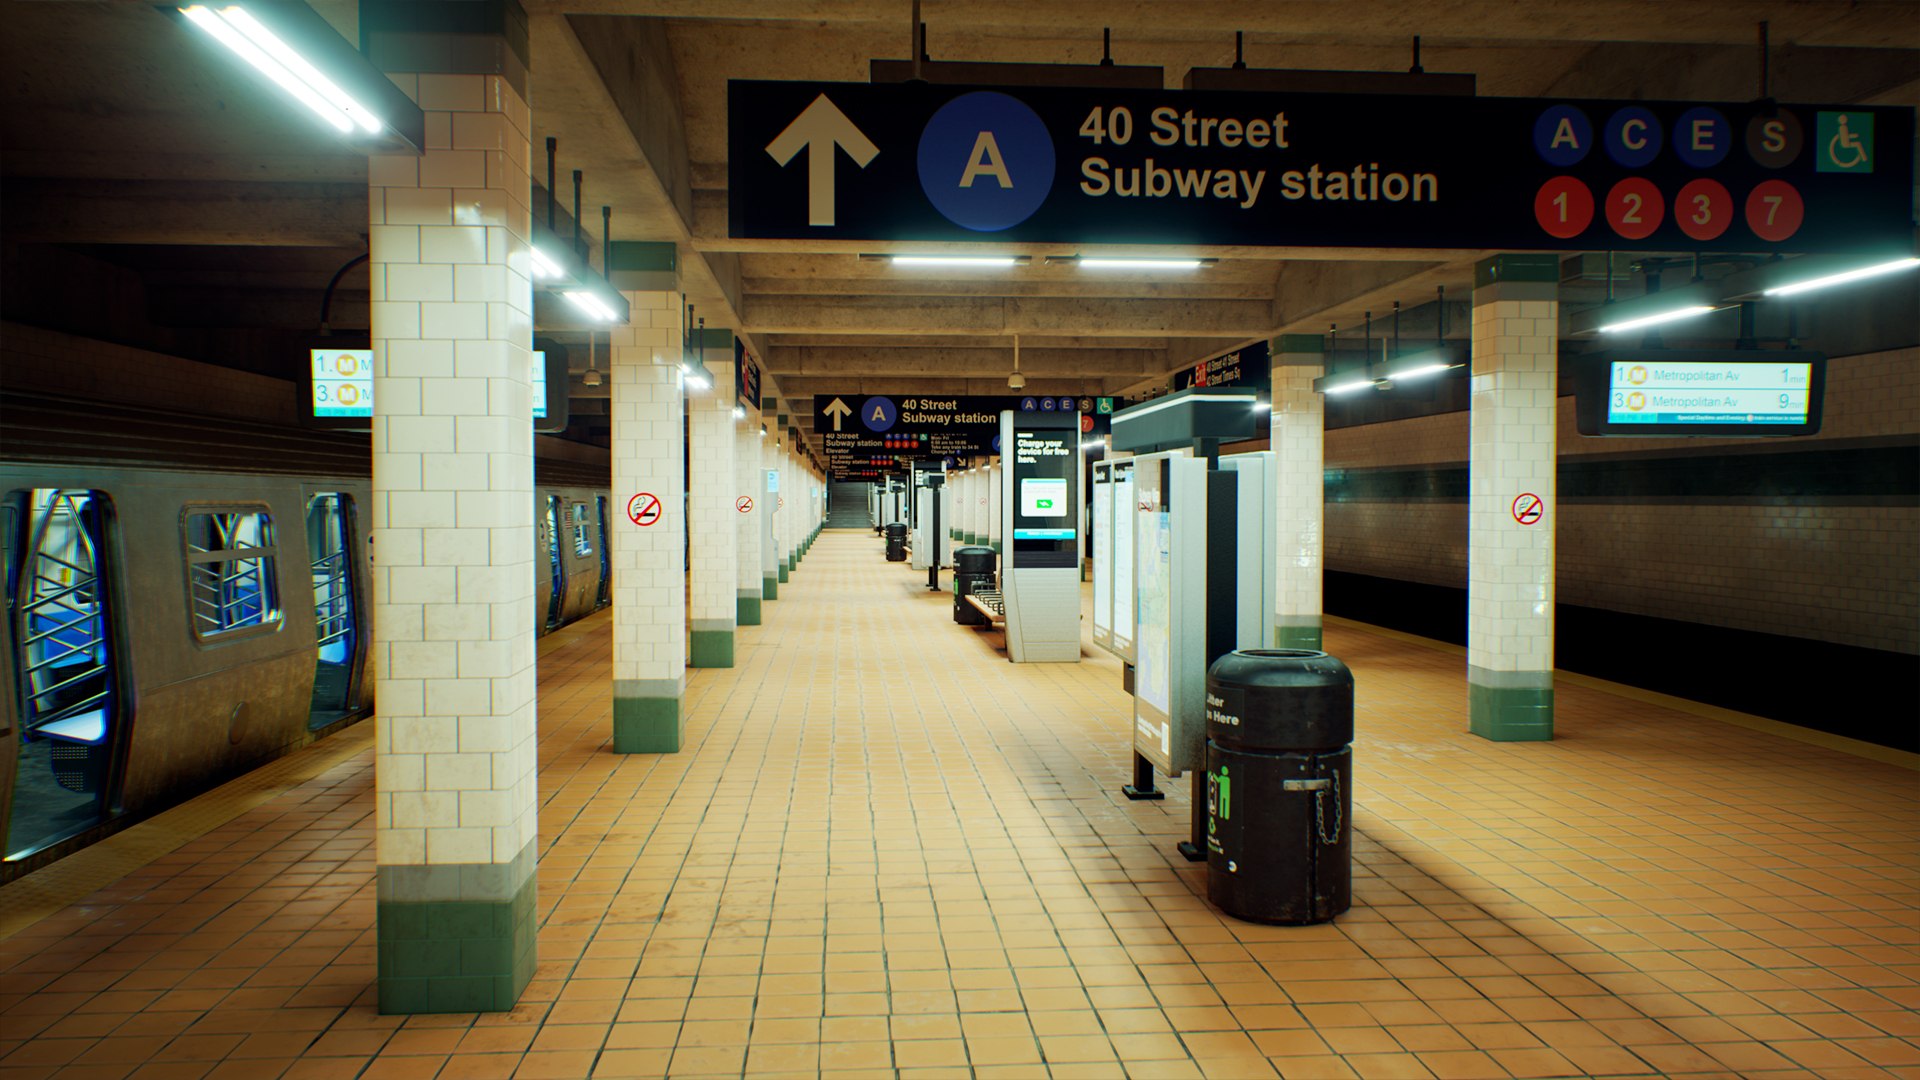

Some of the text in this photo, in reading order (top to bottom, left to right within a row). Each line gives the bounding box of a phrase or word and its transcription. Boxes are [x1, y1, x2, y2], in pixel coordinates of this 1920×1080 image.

[1079, 106, 1289, 149] 40 Street
[1550, 118, 1787, 153] A C E S
[959, 131, 1014, 188] A
[1080, 157, 1439, 209] Subway station
[1552, 192, 1783, 226] 1 2 3 7
[1654, 370, 1724, 383] Metropolitan
[1725, 370, 1740, 381] Av
[902, 399, 957, 410] 40 Street
[1025, 400, 1089, 409] A C E S
[1653, 396, 1723, 409] Metropolitan
[1723, 396, 1738, 407] Av
[871, 406, 886, 421] A
[902, 412, 996, 426] Subway station
[1083, 420, 1088, 428] 7
[826, 439, 856, 448] Subway
[1018, 439, 1063, 449] Charge your
[1018, 447, 1069, 455] device for free
[1018, 455, 1037, 463] here.
[1213, 710, 1240, 726] Here
